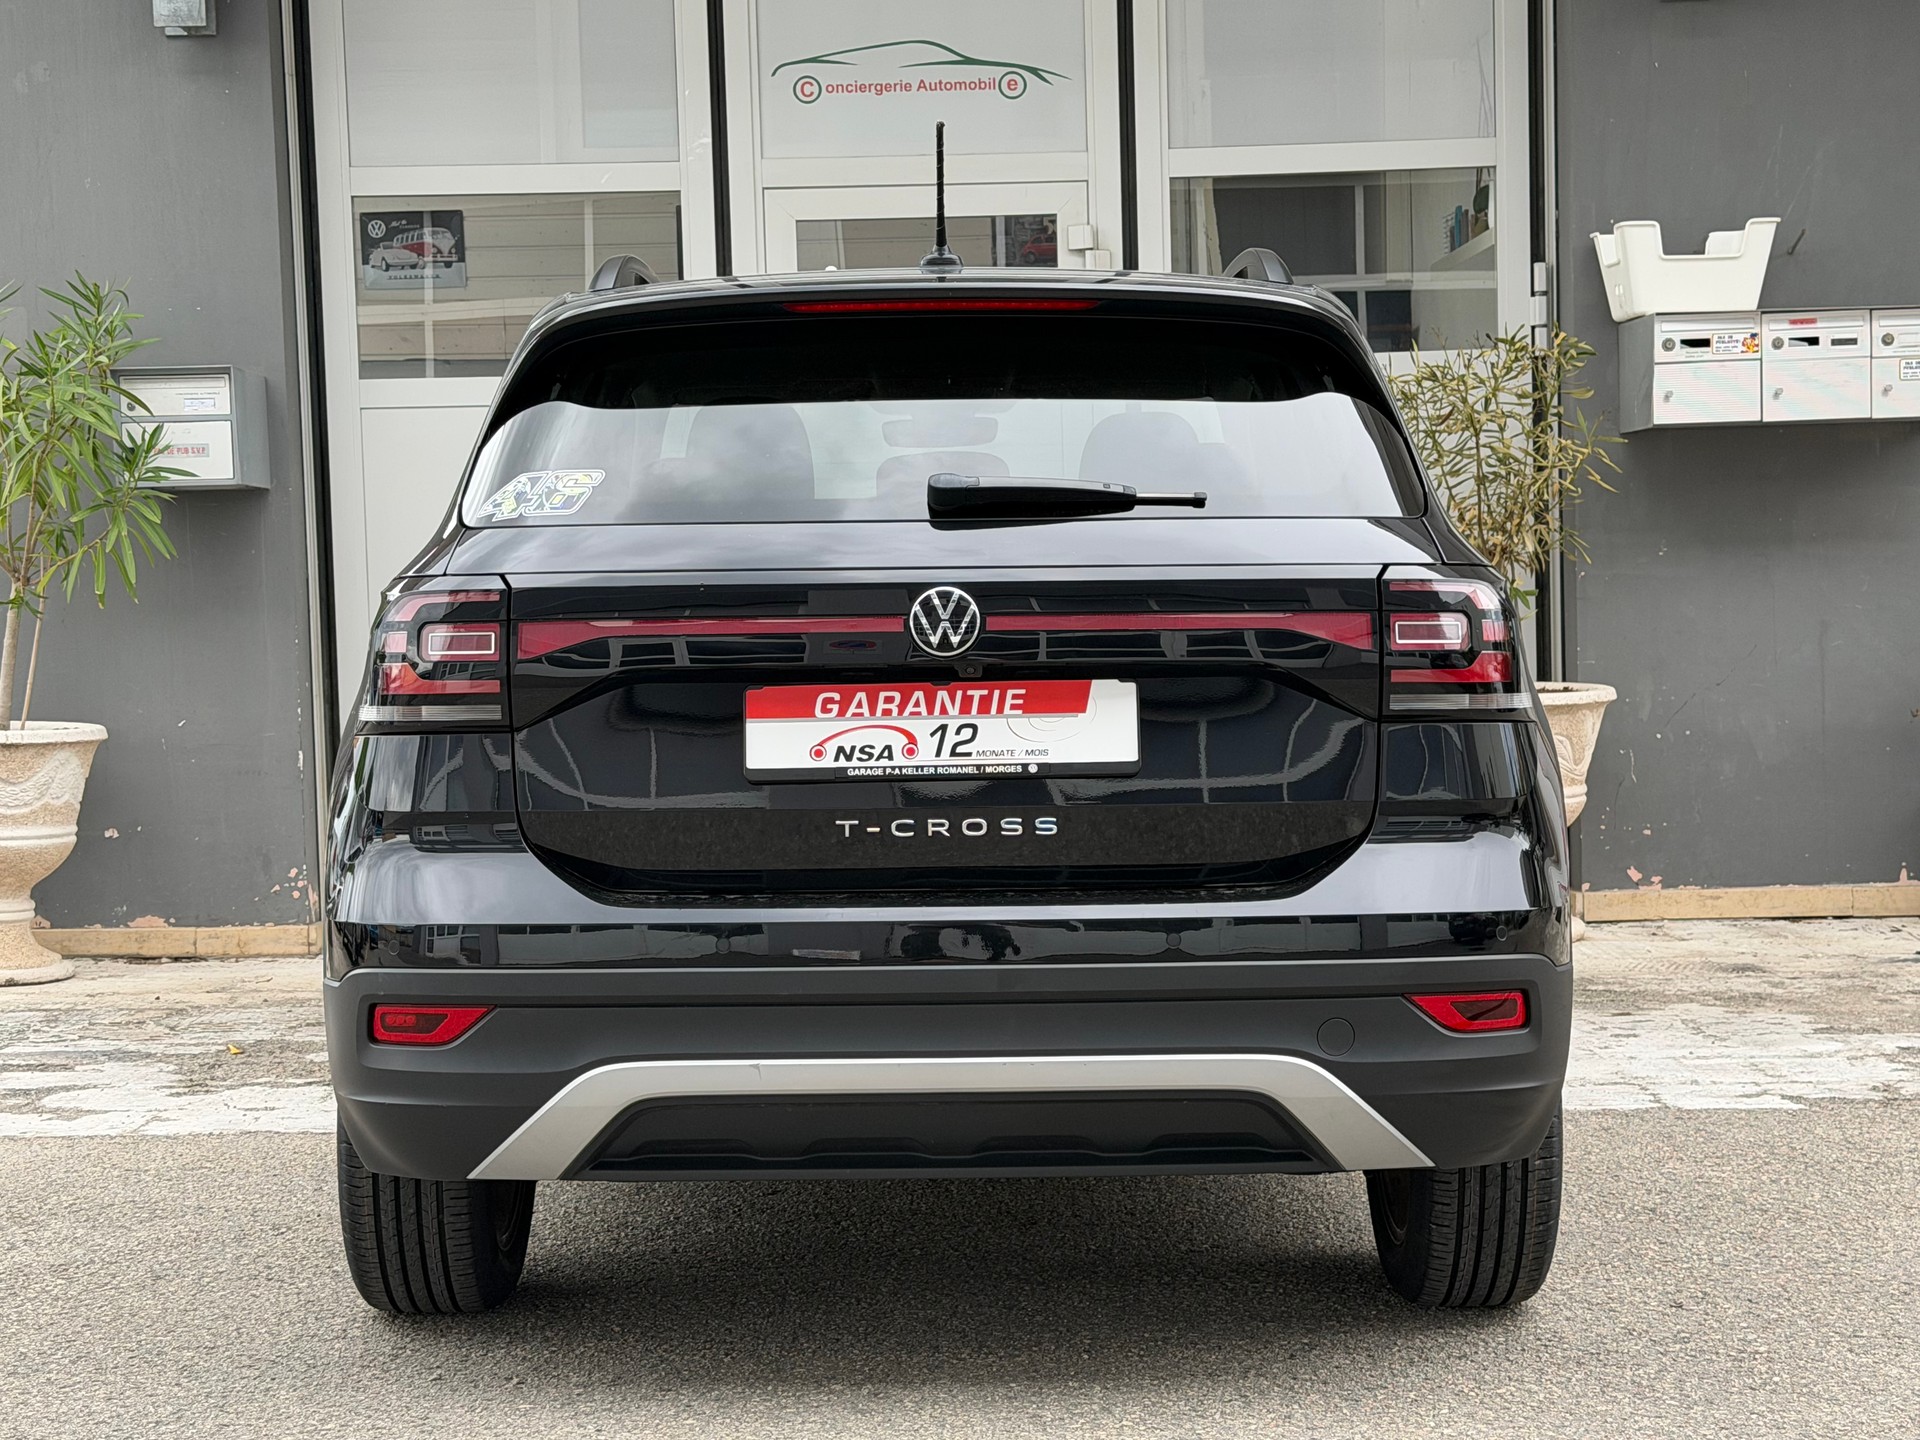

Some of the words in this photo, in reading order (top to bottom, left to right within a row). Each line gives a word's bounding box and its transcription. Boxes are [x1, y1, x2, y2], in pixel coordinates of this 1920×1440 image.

[814, 689, 1027, 718] GARANTIE
[929, 723, 979, 758] 12
[975, 749, 1017, 758] MONATE
[1024, 748, 1049, 757] MOIS
[833, 744, 894, 762] NSA
[847, 767, 884, 776] GARAGE
[885, 767, 901, 775] P-A
[902, 766, 935, 775] KELLER
[937, 765, 980, 774] ROMANEL
[985, 764, 1023, 773] MORGES
[835, 817, 1058, 838] T-CROSS
